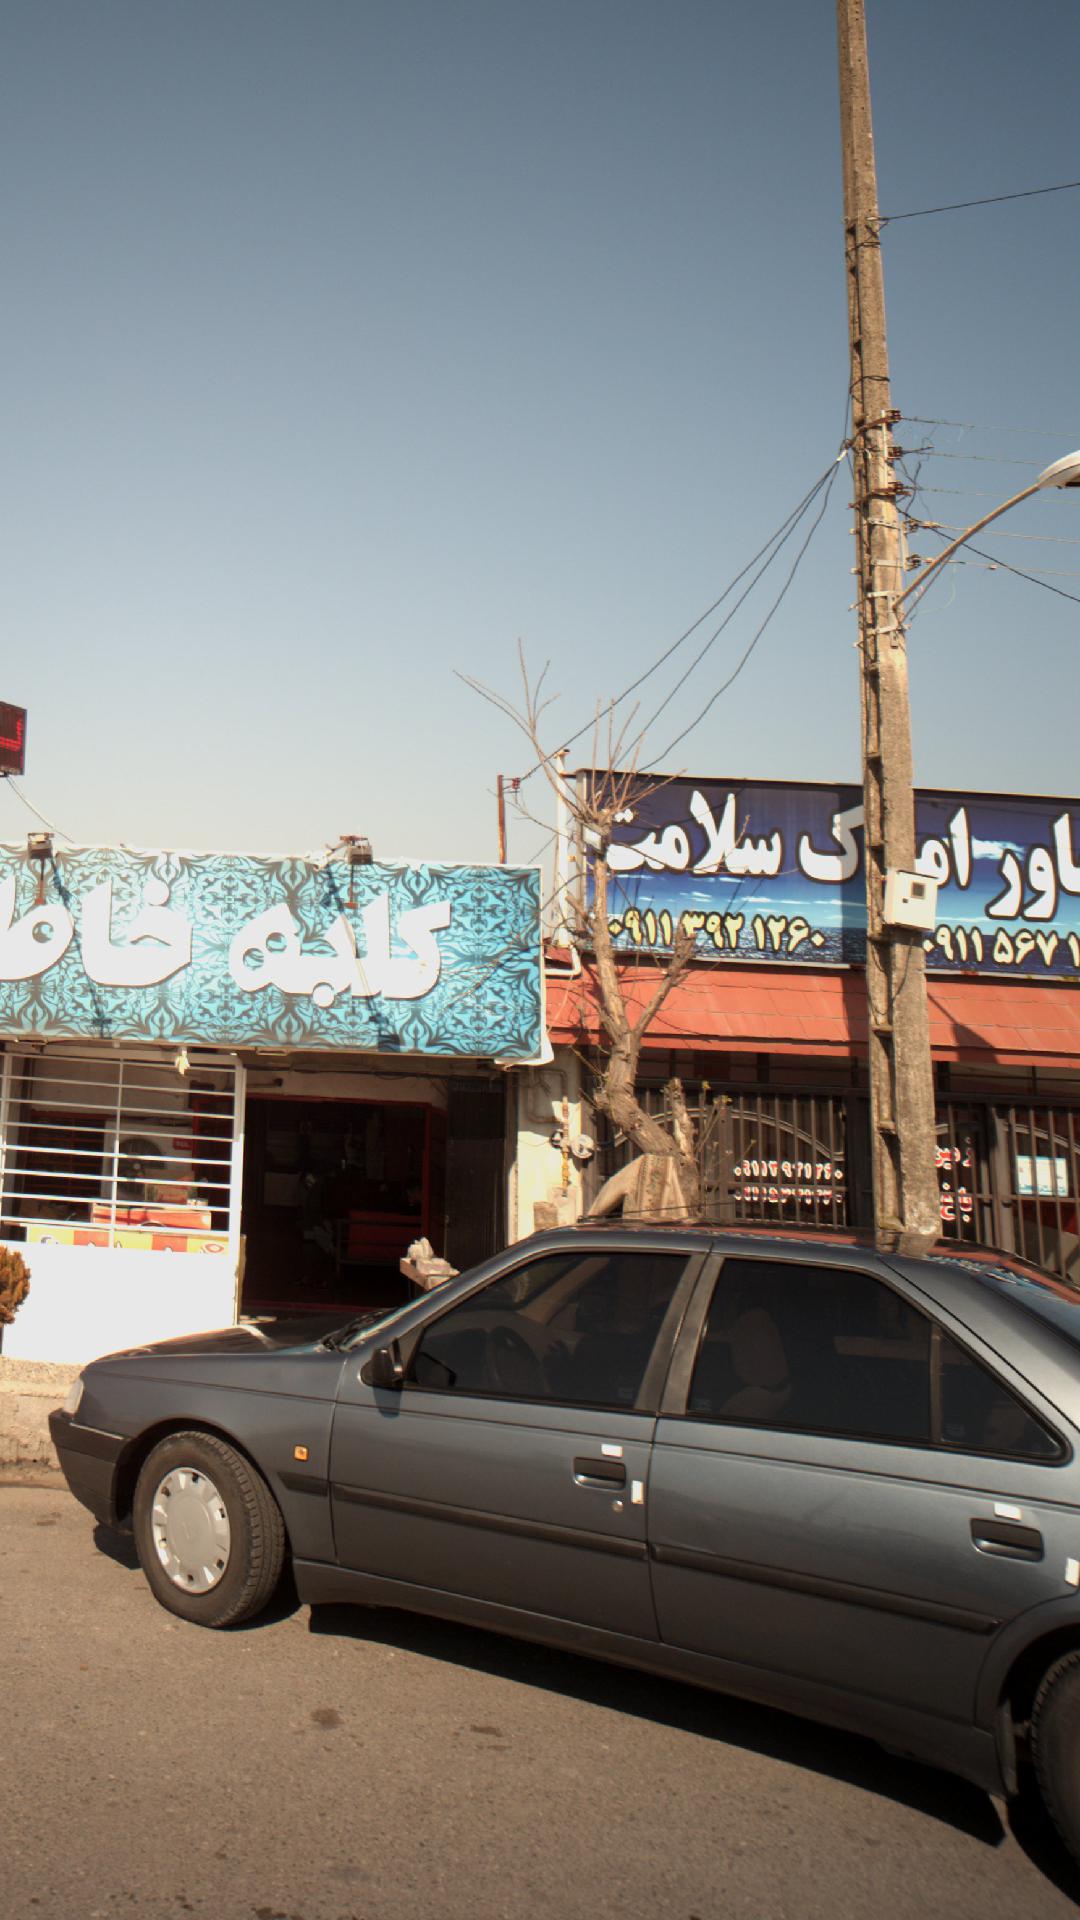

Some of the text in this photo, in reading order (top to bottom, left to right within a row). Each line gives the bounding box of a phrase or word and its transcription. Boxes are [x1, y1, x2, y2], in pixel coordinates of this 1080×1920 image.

[606, 790, 1080, 920] اور امک سلامت
[0, 877, 451, 1008] کلبه خاط
[993, 928, 1059, 967] ۵۶۷
